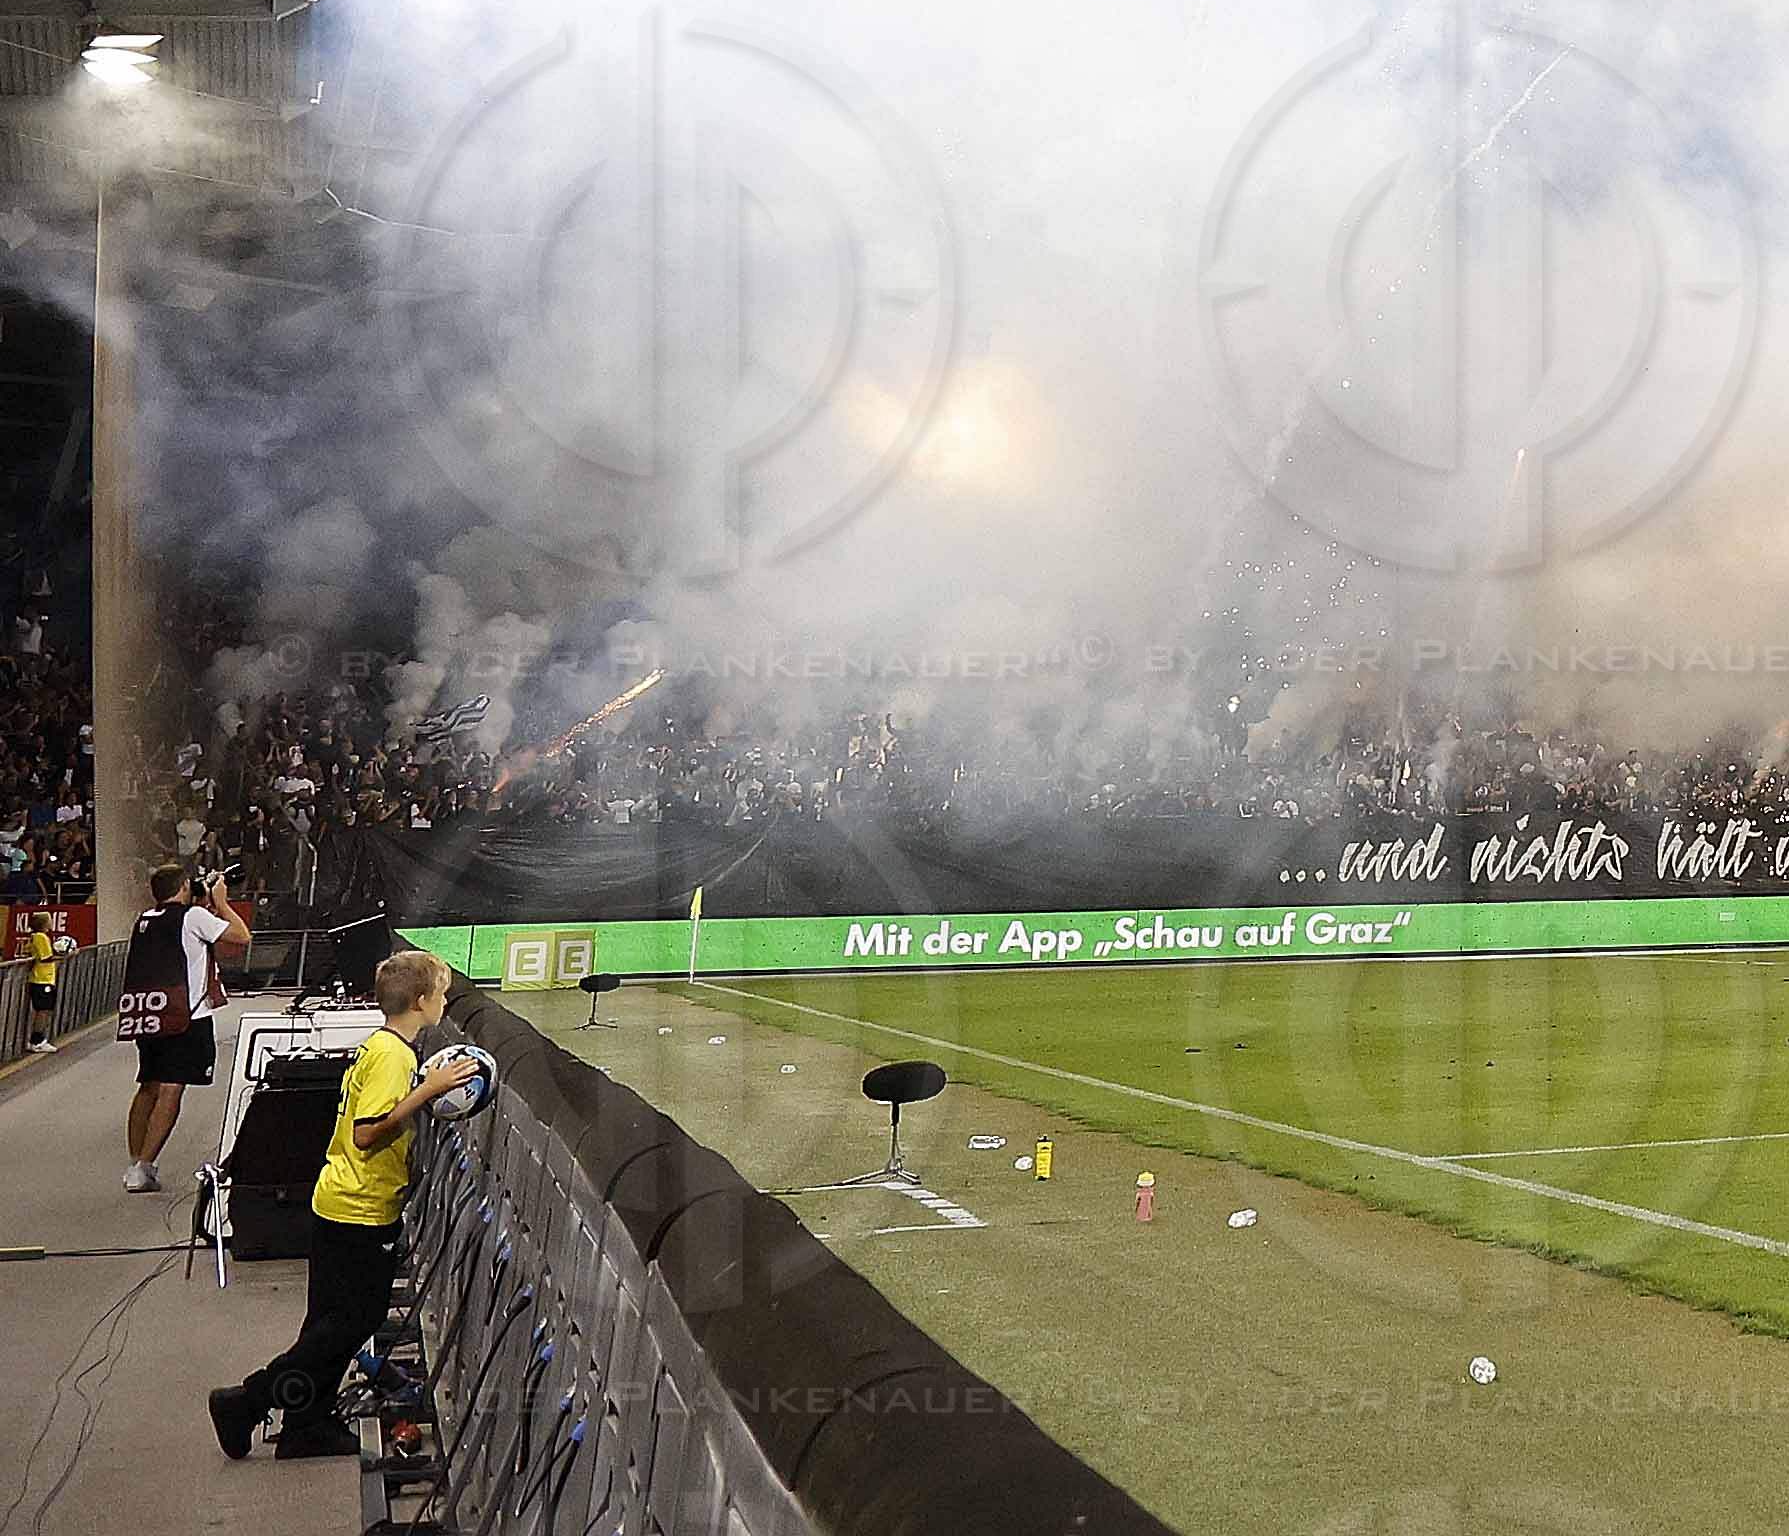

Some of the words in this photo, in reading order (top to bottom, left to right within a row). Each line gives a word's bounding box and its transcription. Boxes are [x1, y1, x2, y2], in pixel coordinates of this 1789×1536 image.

[1470, 814, 1630, 882] nichts
[1656, 816, 1763, 880] hält
[16, 911, 68, 933] KLE
[843, 923, 912, 957] Mit
[922, 920, 988, 955] der
[999, 921, 1082, 960] App
[1095, 915, 1223, 958] „Schau
[1235, 913, 1296, 947] auf
[119, 991, 168, 1013] OTO
[119, 1016, 161, 1036] 213
